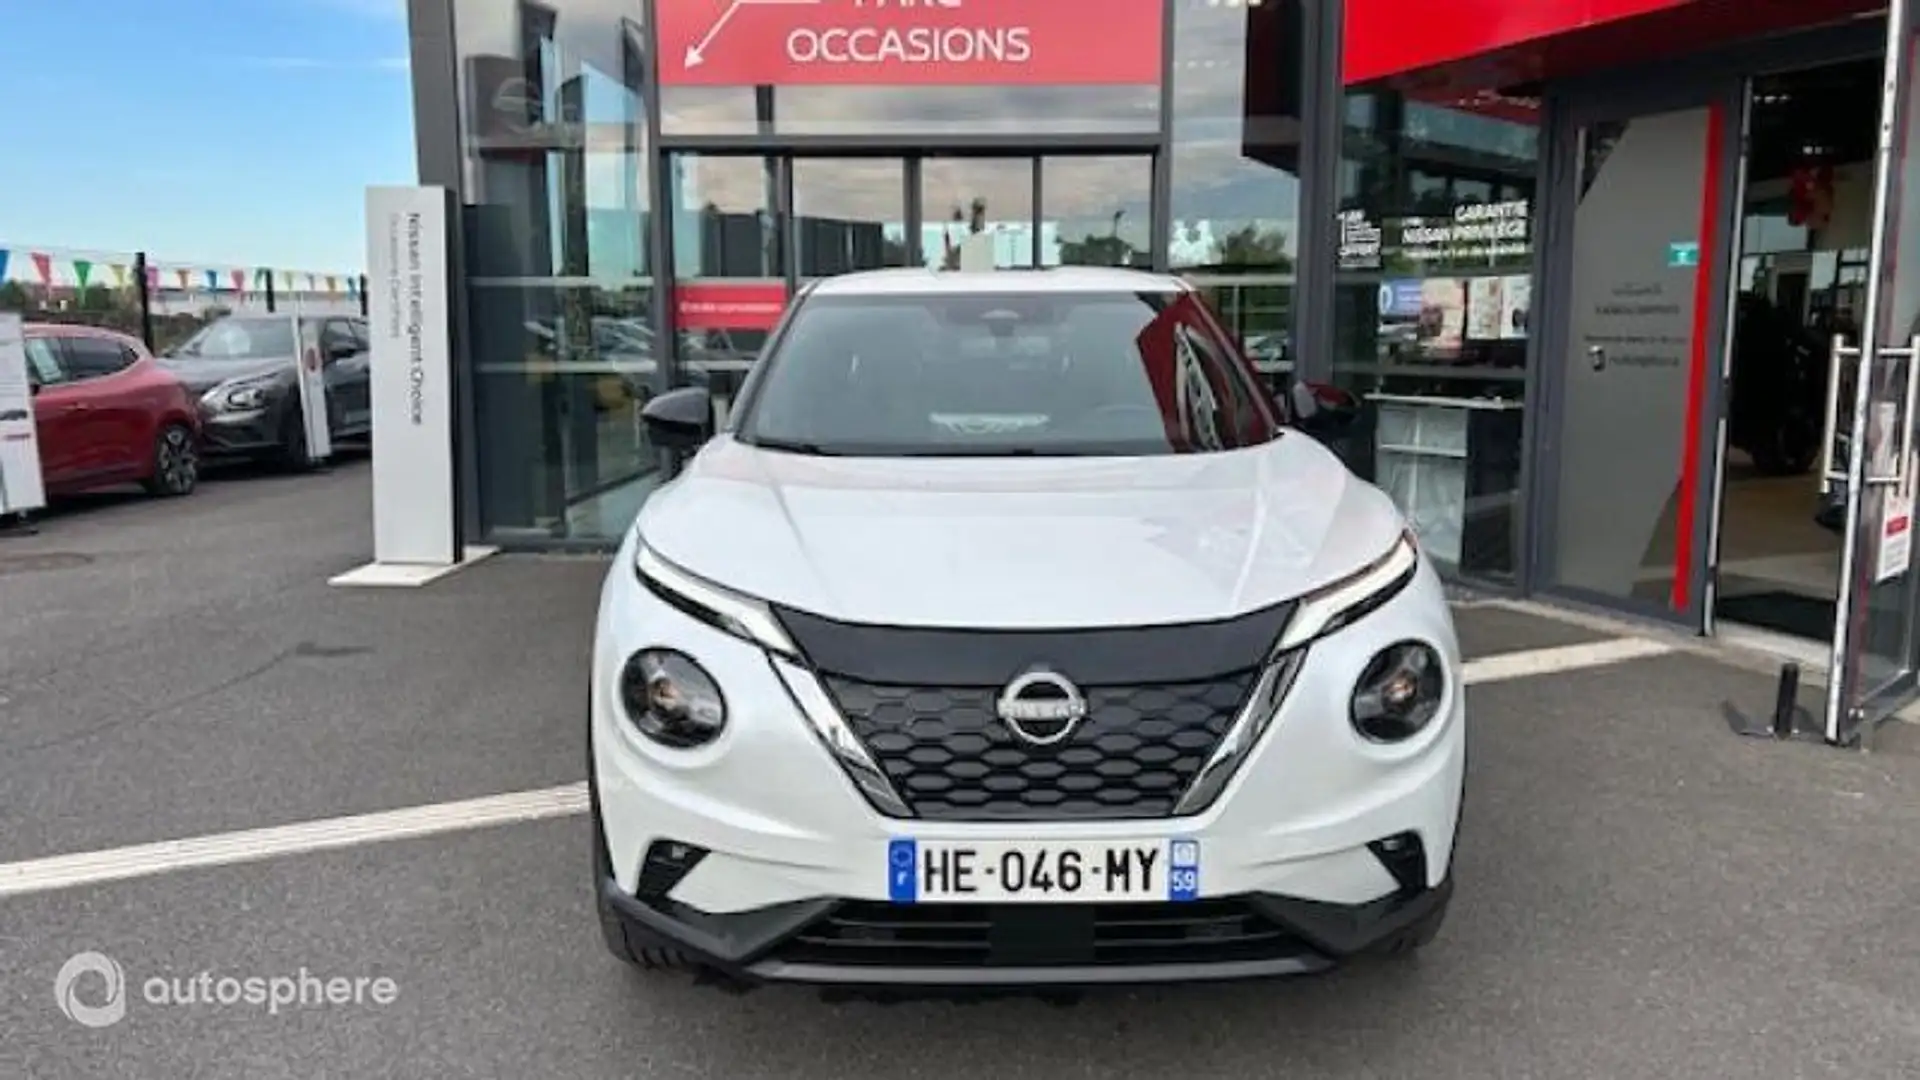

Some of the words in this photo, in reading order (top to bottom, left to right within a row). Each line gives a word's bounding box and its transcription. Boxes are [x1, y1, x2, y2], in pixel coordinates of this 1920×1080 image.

[787, 28, 1031, 62] OCCASIONS
[408, 213, 421, 271] Nissan
[409, 274, 423, 363] Intelligent
[410, 368, 424, 425] Choice
[924, 848, 1159, 893] HE-046-MY
[1173, 870, 1195, 893] 59
